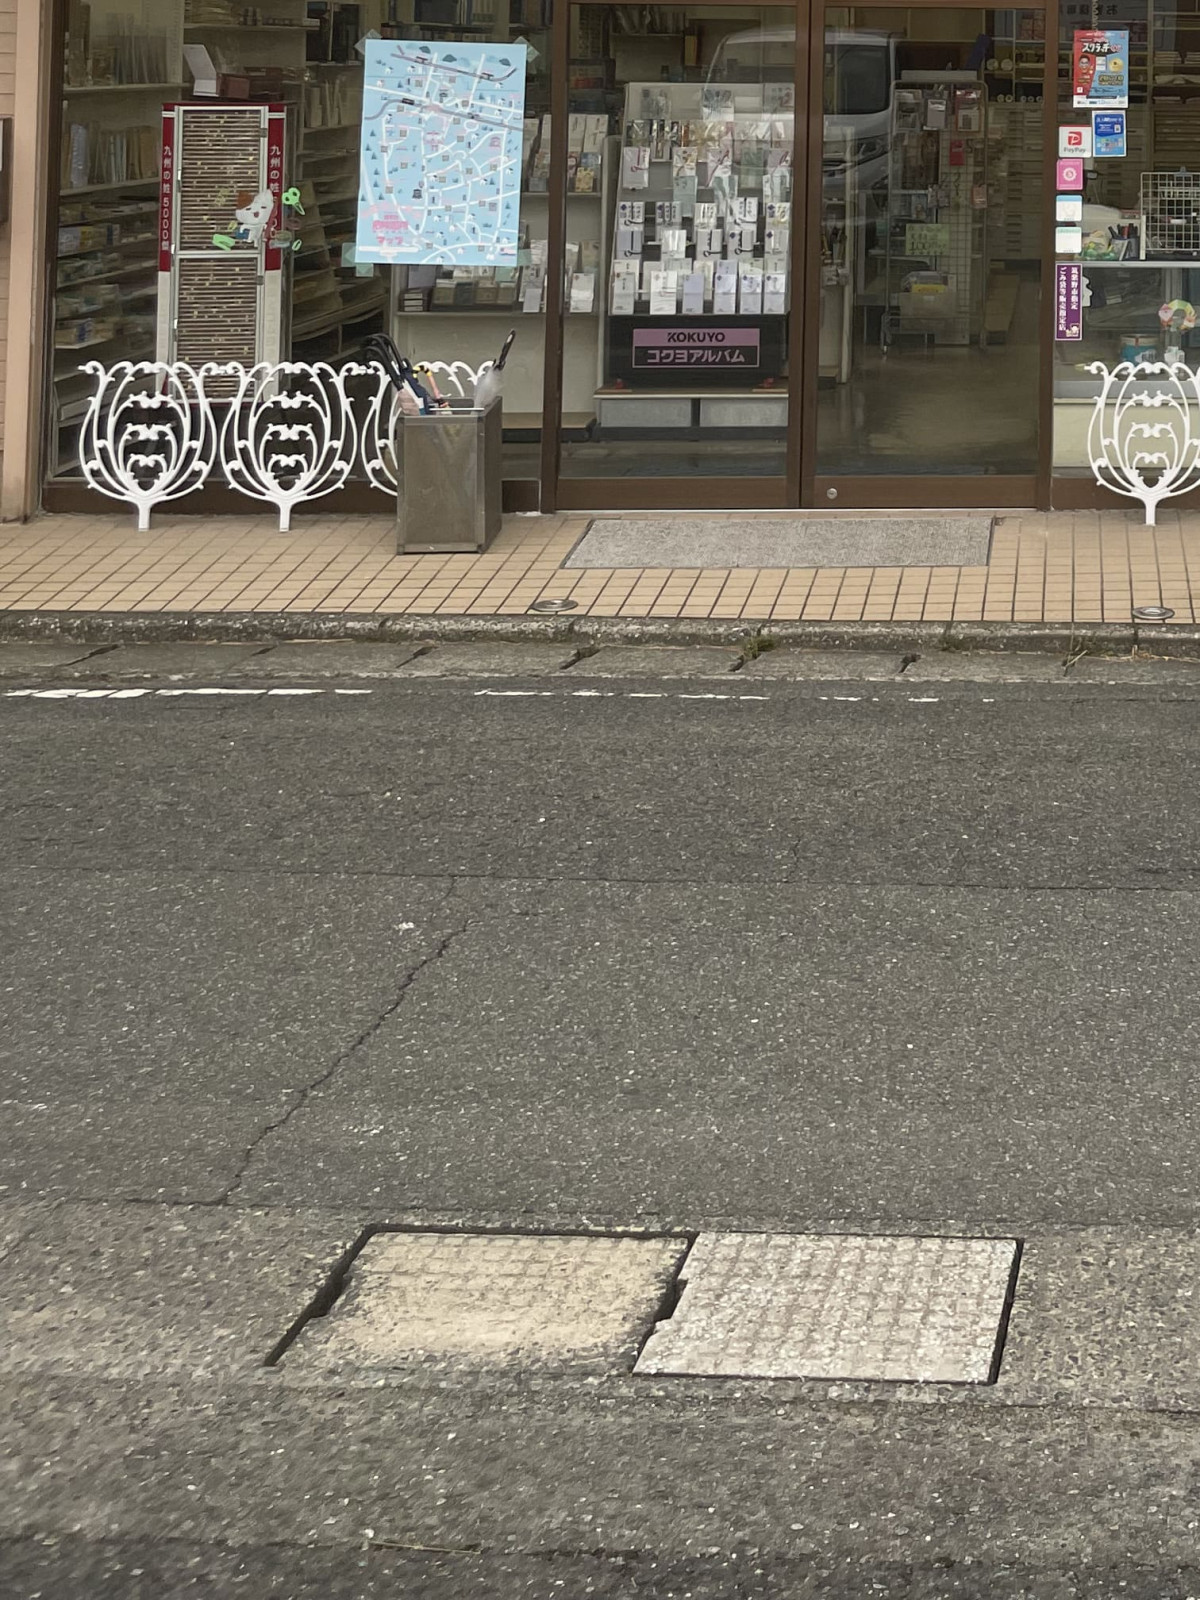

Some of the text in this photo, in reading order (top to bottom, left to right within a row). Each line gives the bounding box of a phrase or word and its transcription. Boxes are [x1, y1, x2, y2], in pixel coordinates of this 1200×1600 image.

[667, 331, 725, 343] KOKUYO
[647, 349, 745, 363] コクヨアルバム
